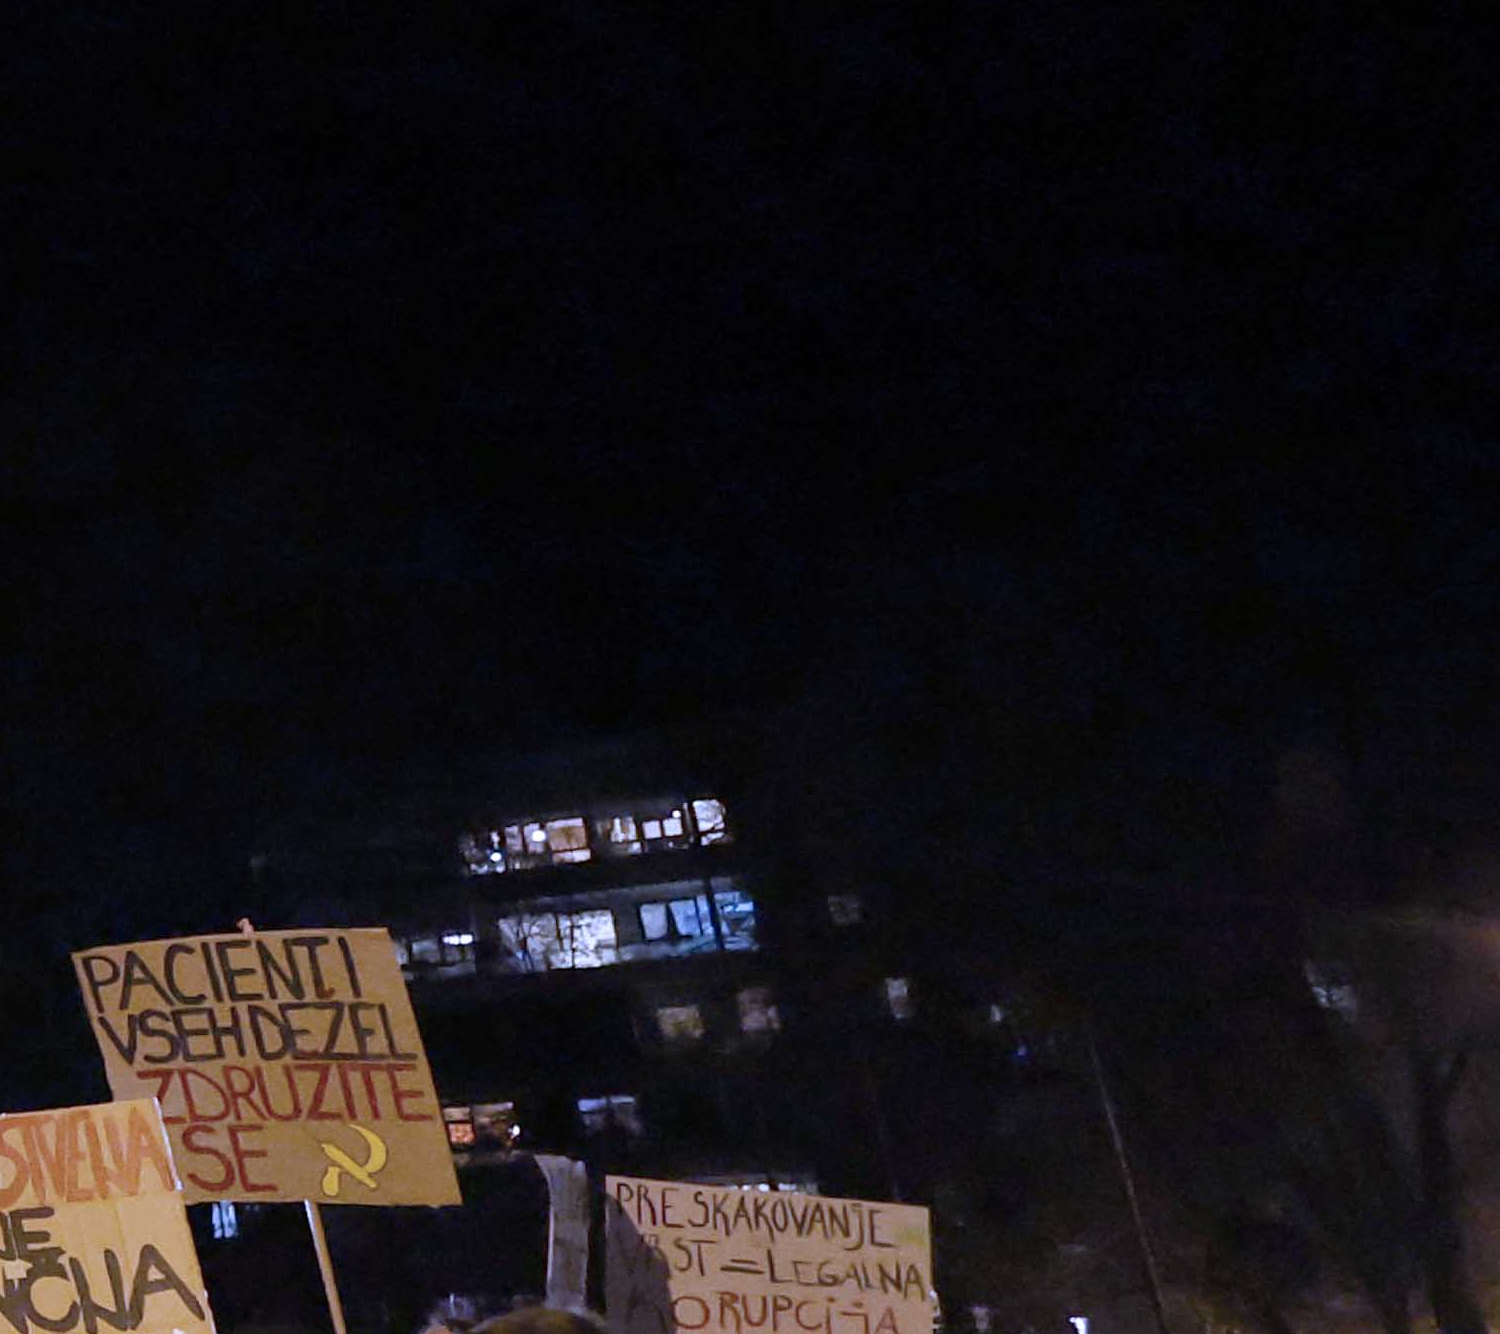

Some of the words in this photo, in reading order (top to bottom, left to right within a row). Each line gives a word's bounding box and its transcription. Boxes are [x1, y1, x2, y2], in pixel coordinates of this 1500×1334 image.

[82, 936, 361, 1013] PACIENTI
[99, 1006, 246, 1065] VSEH
[136, 1062, 433, 1124] ZDRUZITE
[183, 1125, 278, 1192] SE
